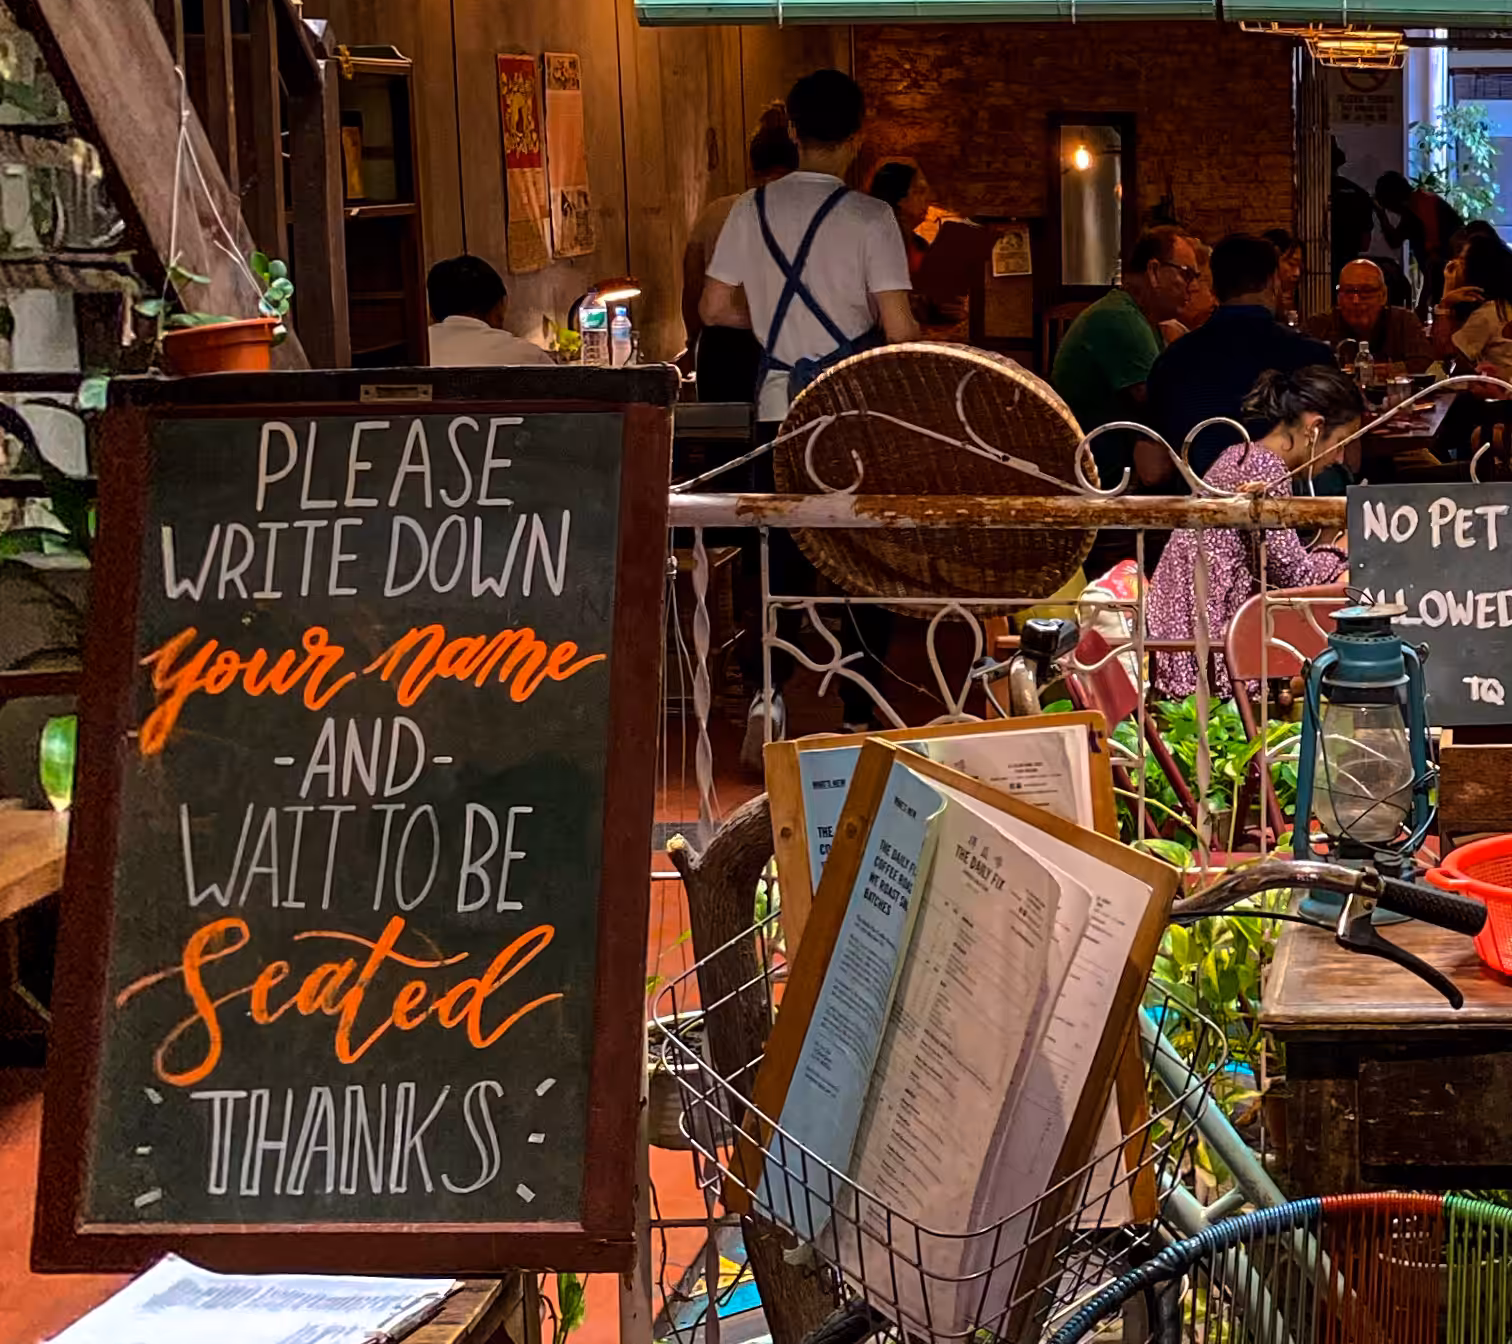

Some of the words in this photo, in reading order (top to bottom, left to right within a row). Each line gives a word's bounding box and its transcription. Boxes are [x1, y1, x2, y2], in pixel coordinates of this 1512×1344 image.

[255, 417, 524, 511] PLEASE
[1362, 501, 1419, 543] NO
[1428, 496, 1510, 551] PET
[161, 518, 364, 599] WRITE
[384, 509, 570, 598] DOWN
[138, 625, 355, 756] your
[364, 623, 606, 705] name
[1463, 676, 1506, 706] TQ
[180, 803, 342, 910] WAIT
[370, 804, 440, 911] TO
[458, 803, 532, 913] BE
[817, 826, 834, 839] THE
[879, 839, 893, 856] THE
[891, 849, 911, 870] DAILY
[908, 862, 918, 877] FI
[869, 871, 881, 887] WE
[879, 879, 901, 903] ROAST
[873, 856, 900, 882] COFFEE
[955, 843, 971, 866] THE
[969, 855, 993, 881] DAILY
[990, 872, 1006, 891] FIX
[863, 887, 892, 916] BATCHES
[116, 914, 564, 1087] Seated
[190, 1080, 505, 1195] THANKS
